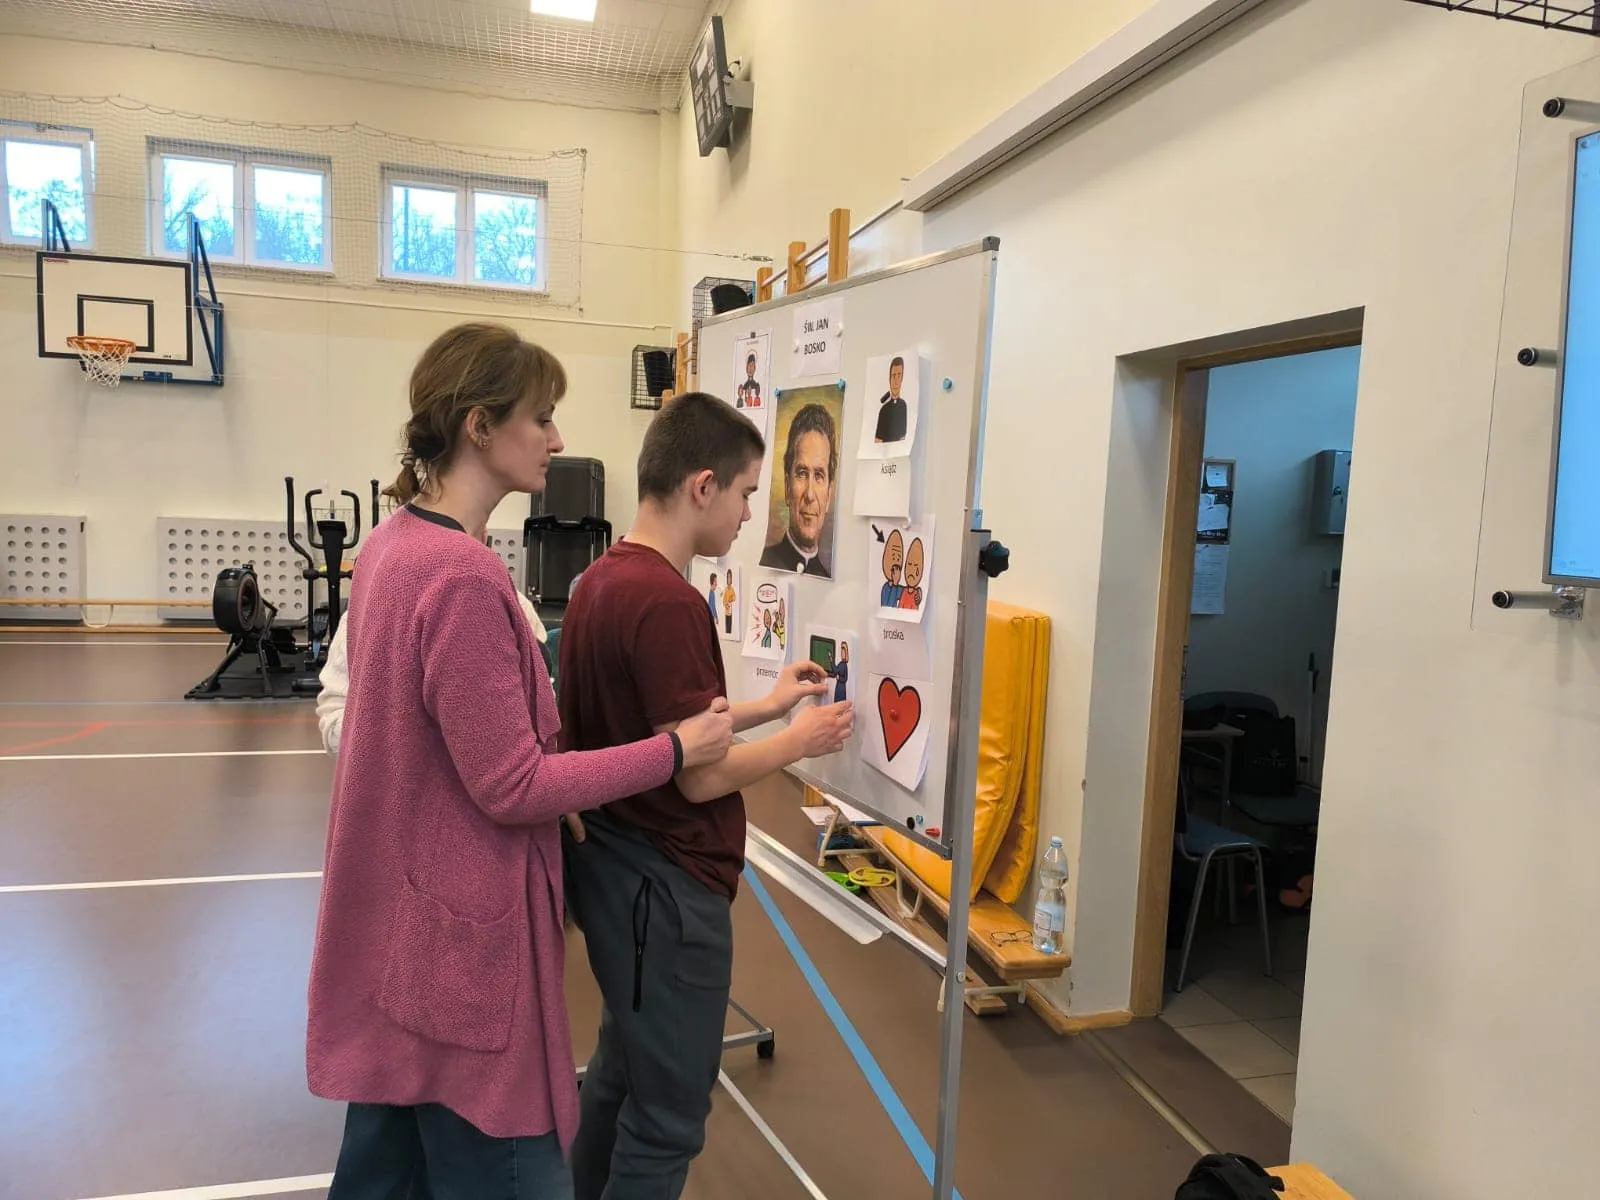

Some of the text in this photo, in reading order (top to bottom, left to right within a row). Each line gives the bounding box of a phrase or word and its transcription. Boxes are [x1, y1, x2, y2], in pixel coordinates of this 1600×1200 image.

[816, 317, 829, 331] JAN
[803, 340, 826, 355] BOSKO
[882, 629, 905, 641] troska
